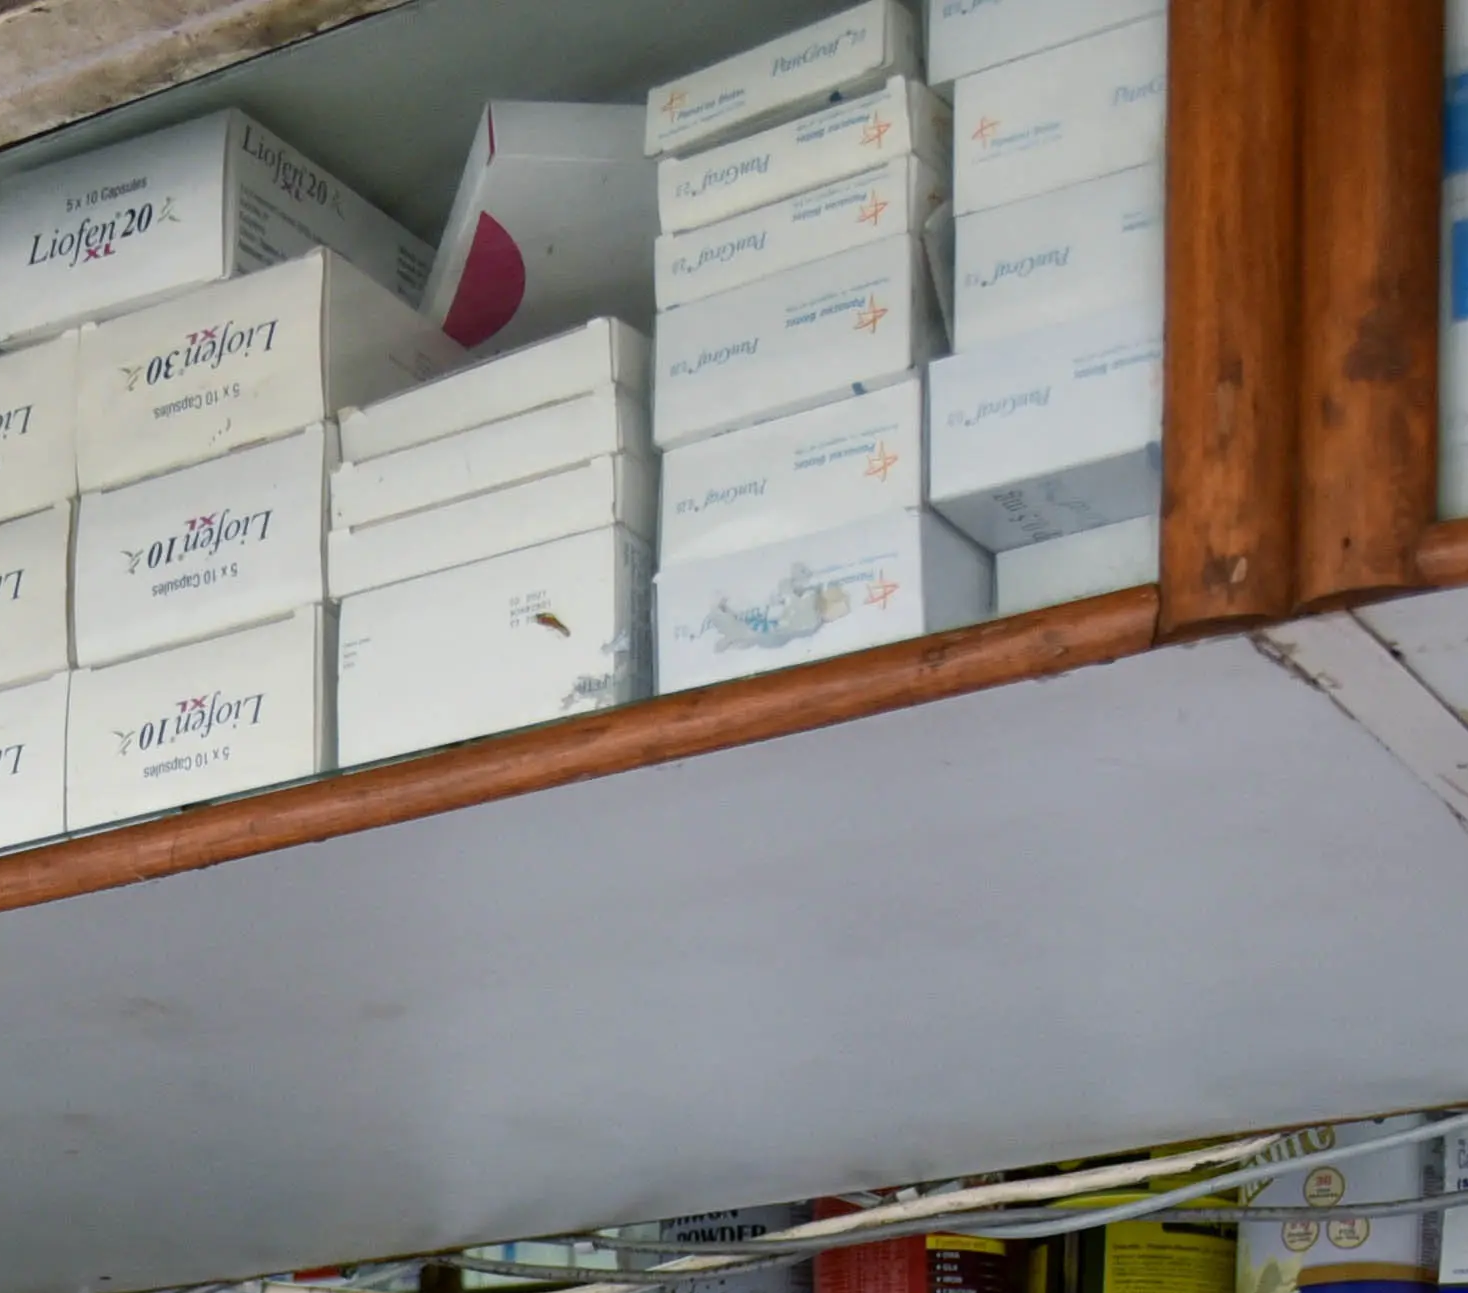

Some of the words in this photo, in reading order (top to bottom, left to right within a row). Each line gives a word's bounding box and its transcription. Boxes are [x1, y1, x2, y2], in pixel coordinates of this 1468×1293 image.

[101, 176, 148, 205] Capsules
[29, 218, 116, 266] Liofen
[186, 319, 280, 372] Liofen
[153, 394, 202, 419] Capsules
[177, 508, 272, 559] Liofen
[152, 574, 200, 598] Capsules
[175, 694, 264, 745] Liofen
[144, 756, 194, 779] Capsules
